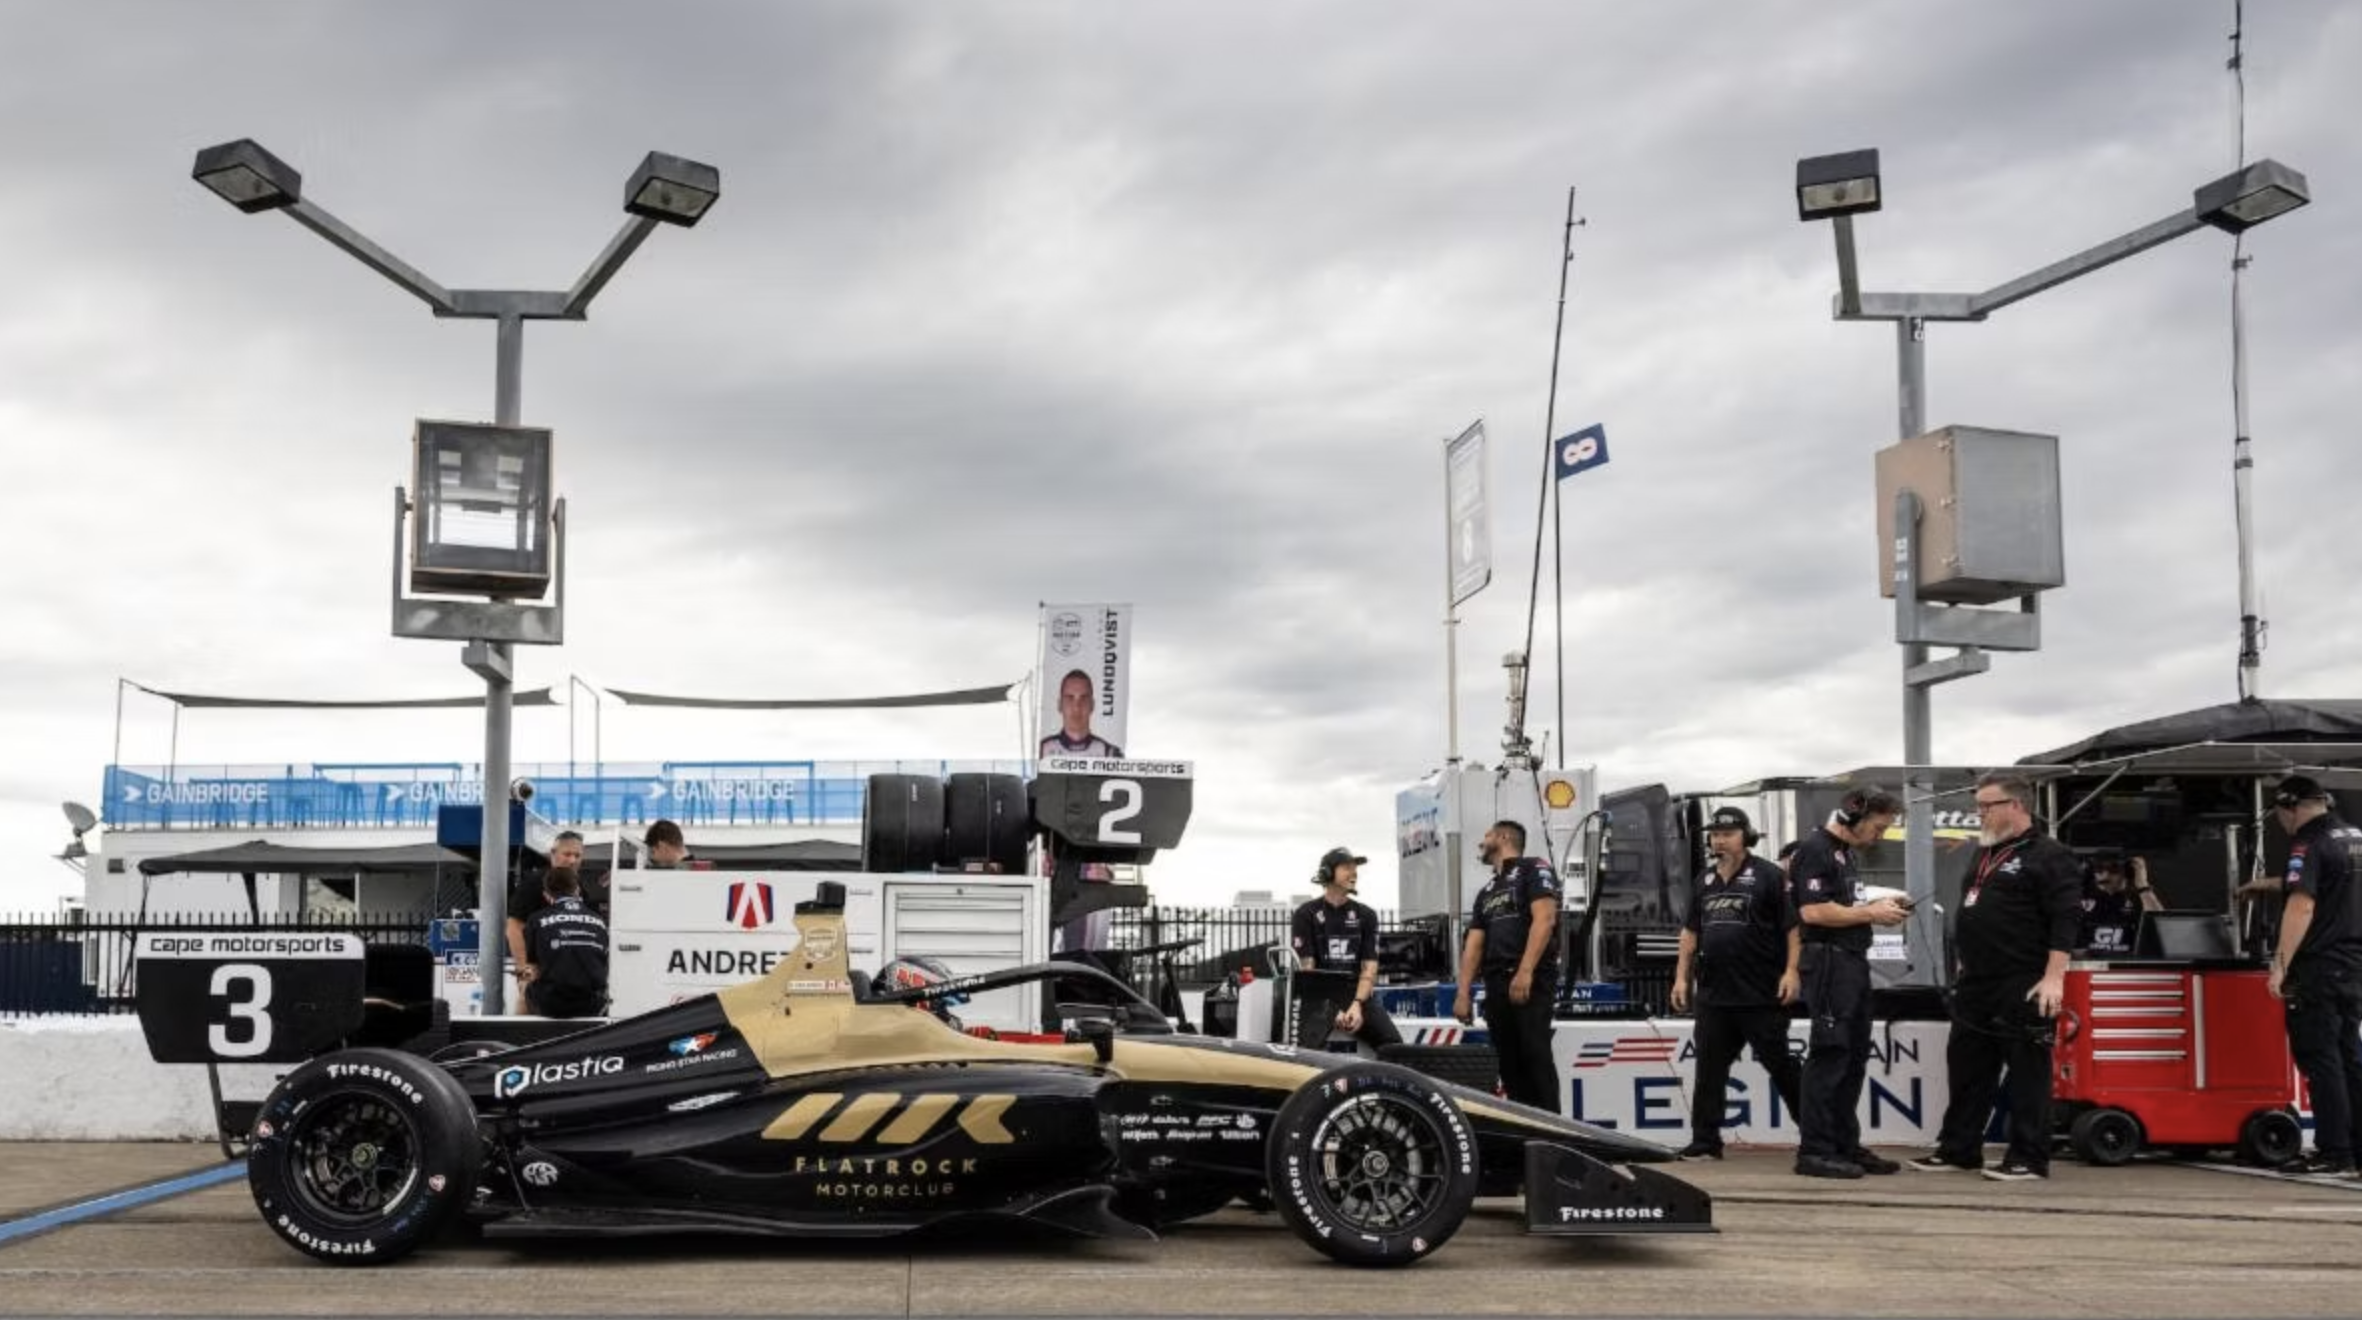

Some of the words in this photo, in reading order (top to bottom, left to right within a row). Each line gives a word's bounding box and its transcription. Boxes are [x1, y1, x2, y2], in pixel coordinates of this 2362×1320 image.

[1562, 436, 1598, 466] 8
[1102, 608, 1118, 718] LUNDQVIST
[1050, 758, 1088, 772] cape
[1092, 759, 1185, 775] motorsports
[146, 781, 268, 804] GAINBRIDGE
[409, 781, 485, 802] GAINBR
[672, 779, 795, 801] GAINBRIDGE
[1097, 778, 1142, 844] 2
[540, 914, 607, 931] HONDA
[150, 937, 203, 956] cape
[211, 935, 345, 956] motorsports
[208, 963, 272, 1057] 3
[1678, 1038, 1920, 1063] ARAN
[326, 1063, 424, 1104] Firestone
[1571, 1076, 1924, 1130] LEGIN
[1429, 1092, 1471, 1174] Firestone
[796, 1157, 978, 1174] FLATROCK
[816, 1183, 954, 1197] MOTORCLUB
[1288, 1155, 1333, 1239] Firestone
[1558, 1206, 1665, 1222] Firestone
[278, 1214, 376, 1255] Firestone
